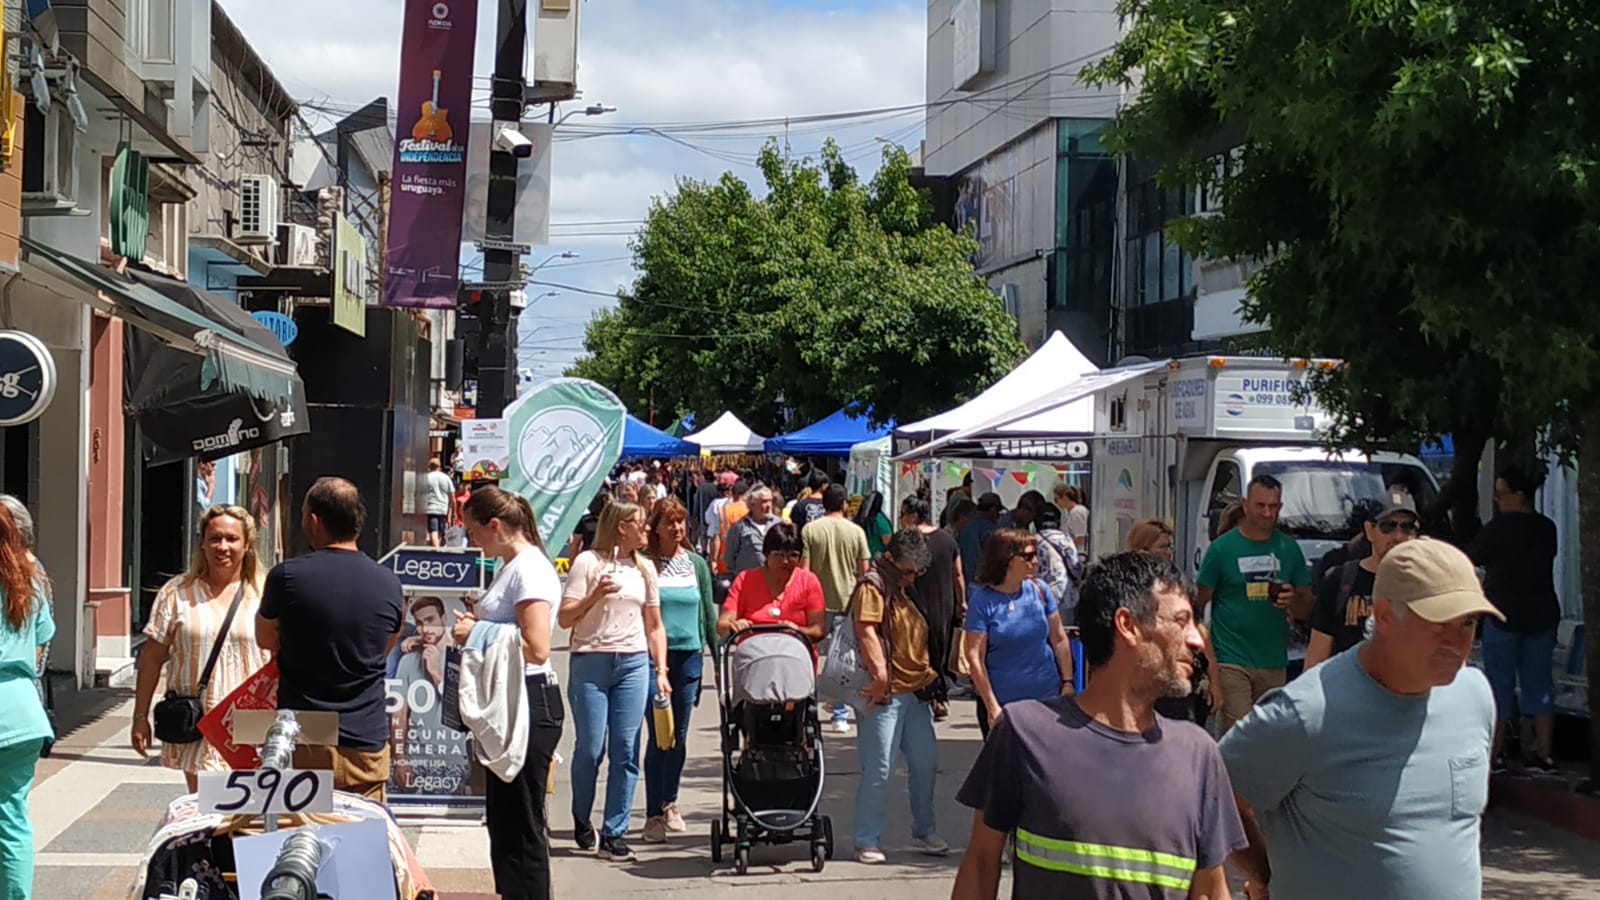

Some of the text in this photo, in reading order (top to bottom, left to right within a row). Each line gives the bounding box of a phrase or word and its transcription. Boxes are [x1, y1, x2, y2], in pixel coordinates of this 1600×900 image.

[399, 139, 453, 152] Festival
[400, 152, 462, 162] INDEPENDENCIA
[402, 174, 456, 187] La fiesta más
[1256, 393, 1273, 404] 099
[981, 440, 1088, 458] YUMBO
[393, 554, 471, 583] Legacy
[384, 679, 436, 713] 50
[408, 718, 425, 726] LA
[394, 729, 475, 740] EGUNDA
[395, 743, 462, 755] EMERA
[393, 759, 447, 768] HOMBRE LISA
[405, 772, 462, 792] Legacy
[214, 767, 319, 814] 590
